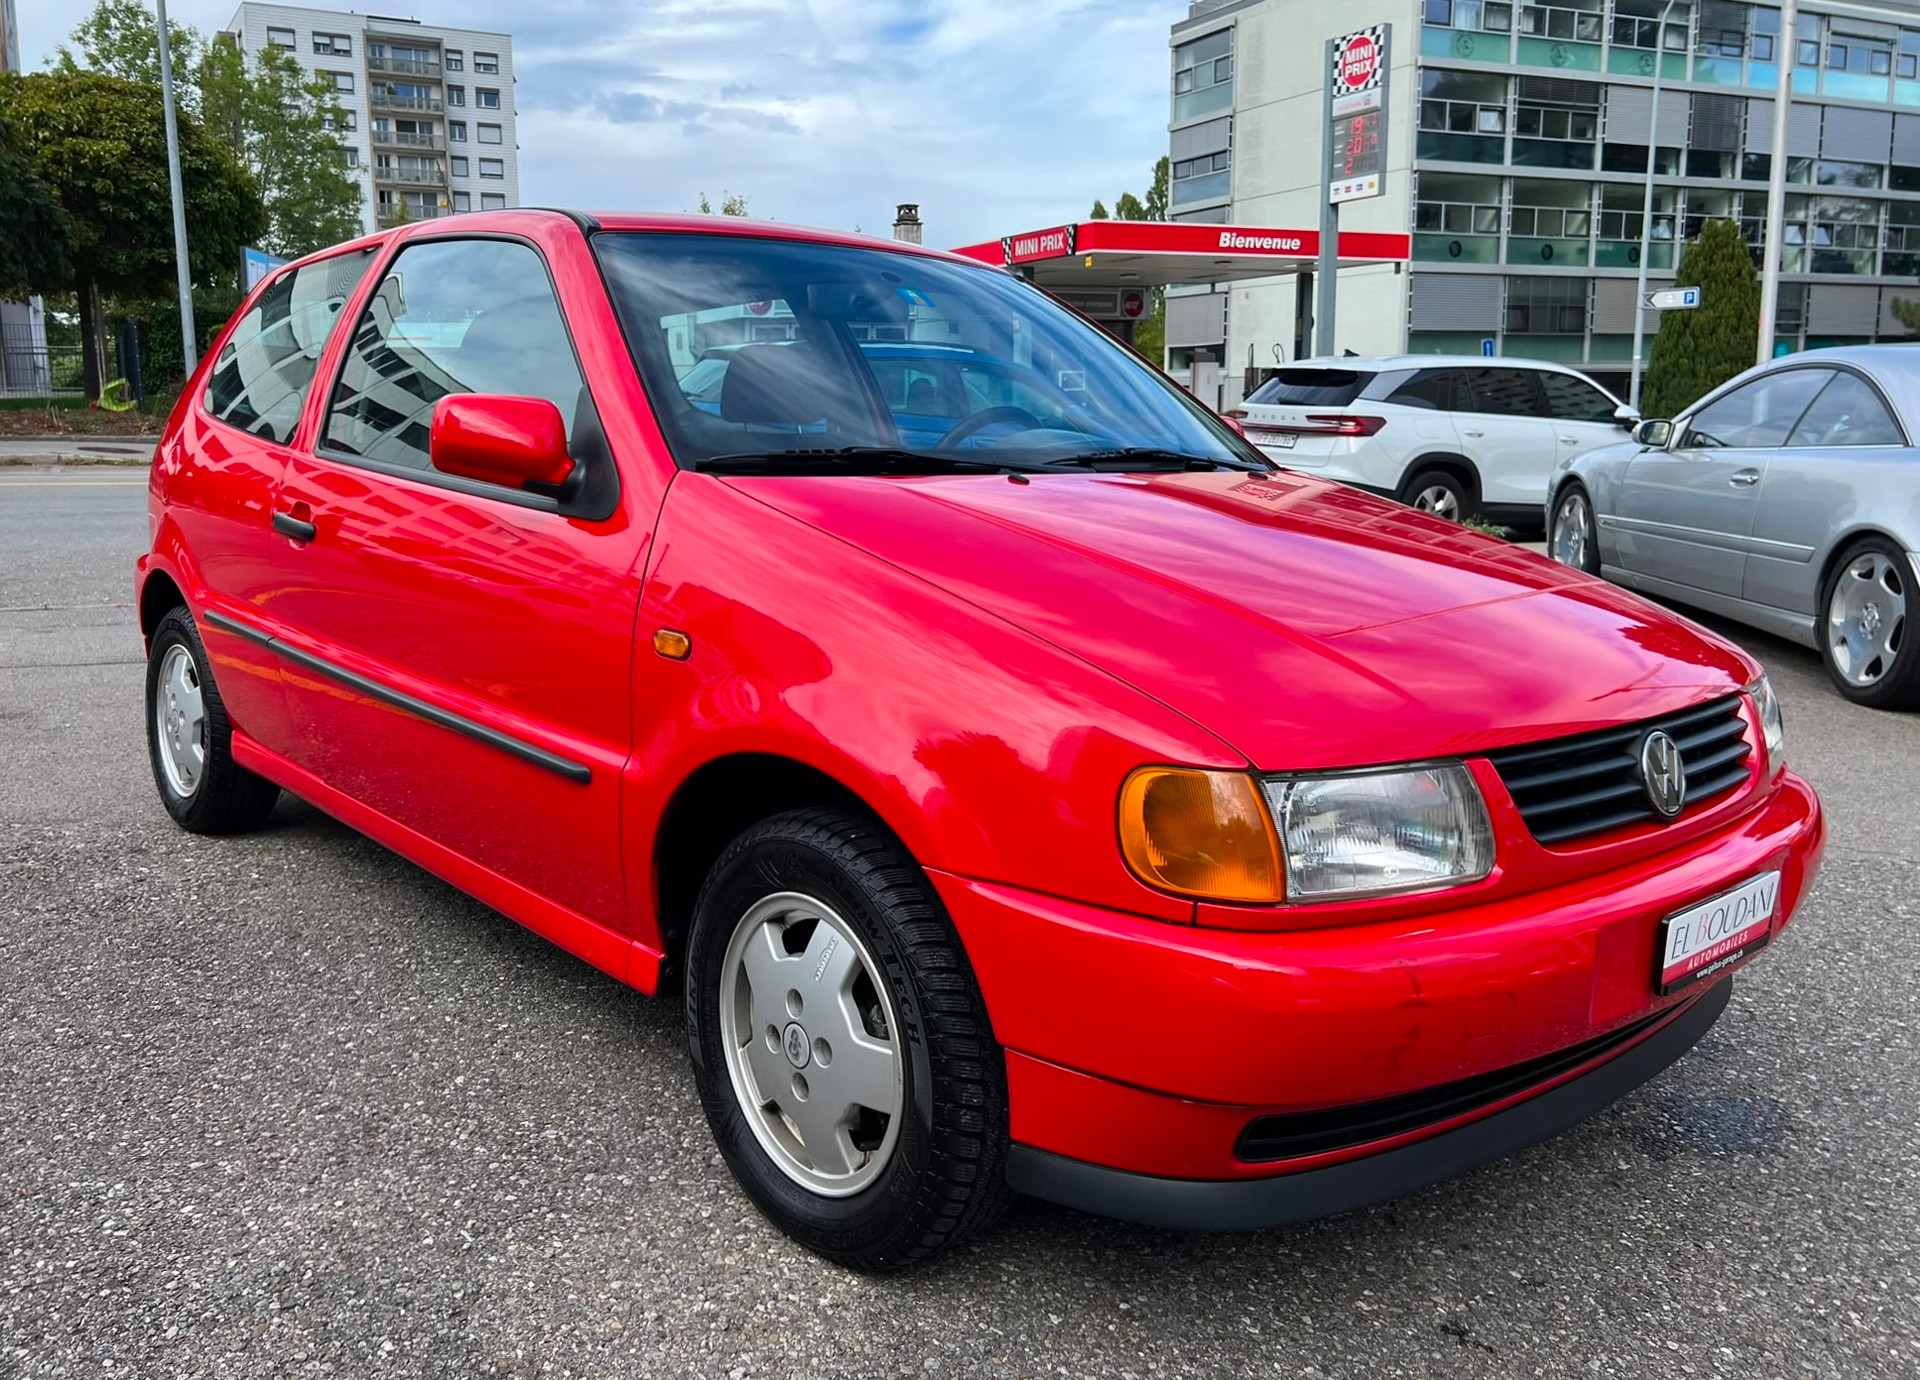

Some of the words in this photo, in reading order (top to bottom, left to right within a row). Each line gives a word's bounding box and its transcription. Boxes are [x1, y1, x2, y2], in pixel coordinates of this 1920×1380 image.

[1345, 44, 1372, 64] MINI
[1345, 59, 1372, 79] PRIX
[1015, 237, 1038, 257] MINI
[1040, 233, 1064, 253] PRIX
[1219, 231, 1301, 250] Bienvenue
[1671, 922, 1690, 960] EL
[1687, 931, 1749, 971] AUTOMOBILES
